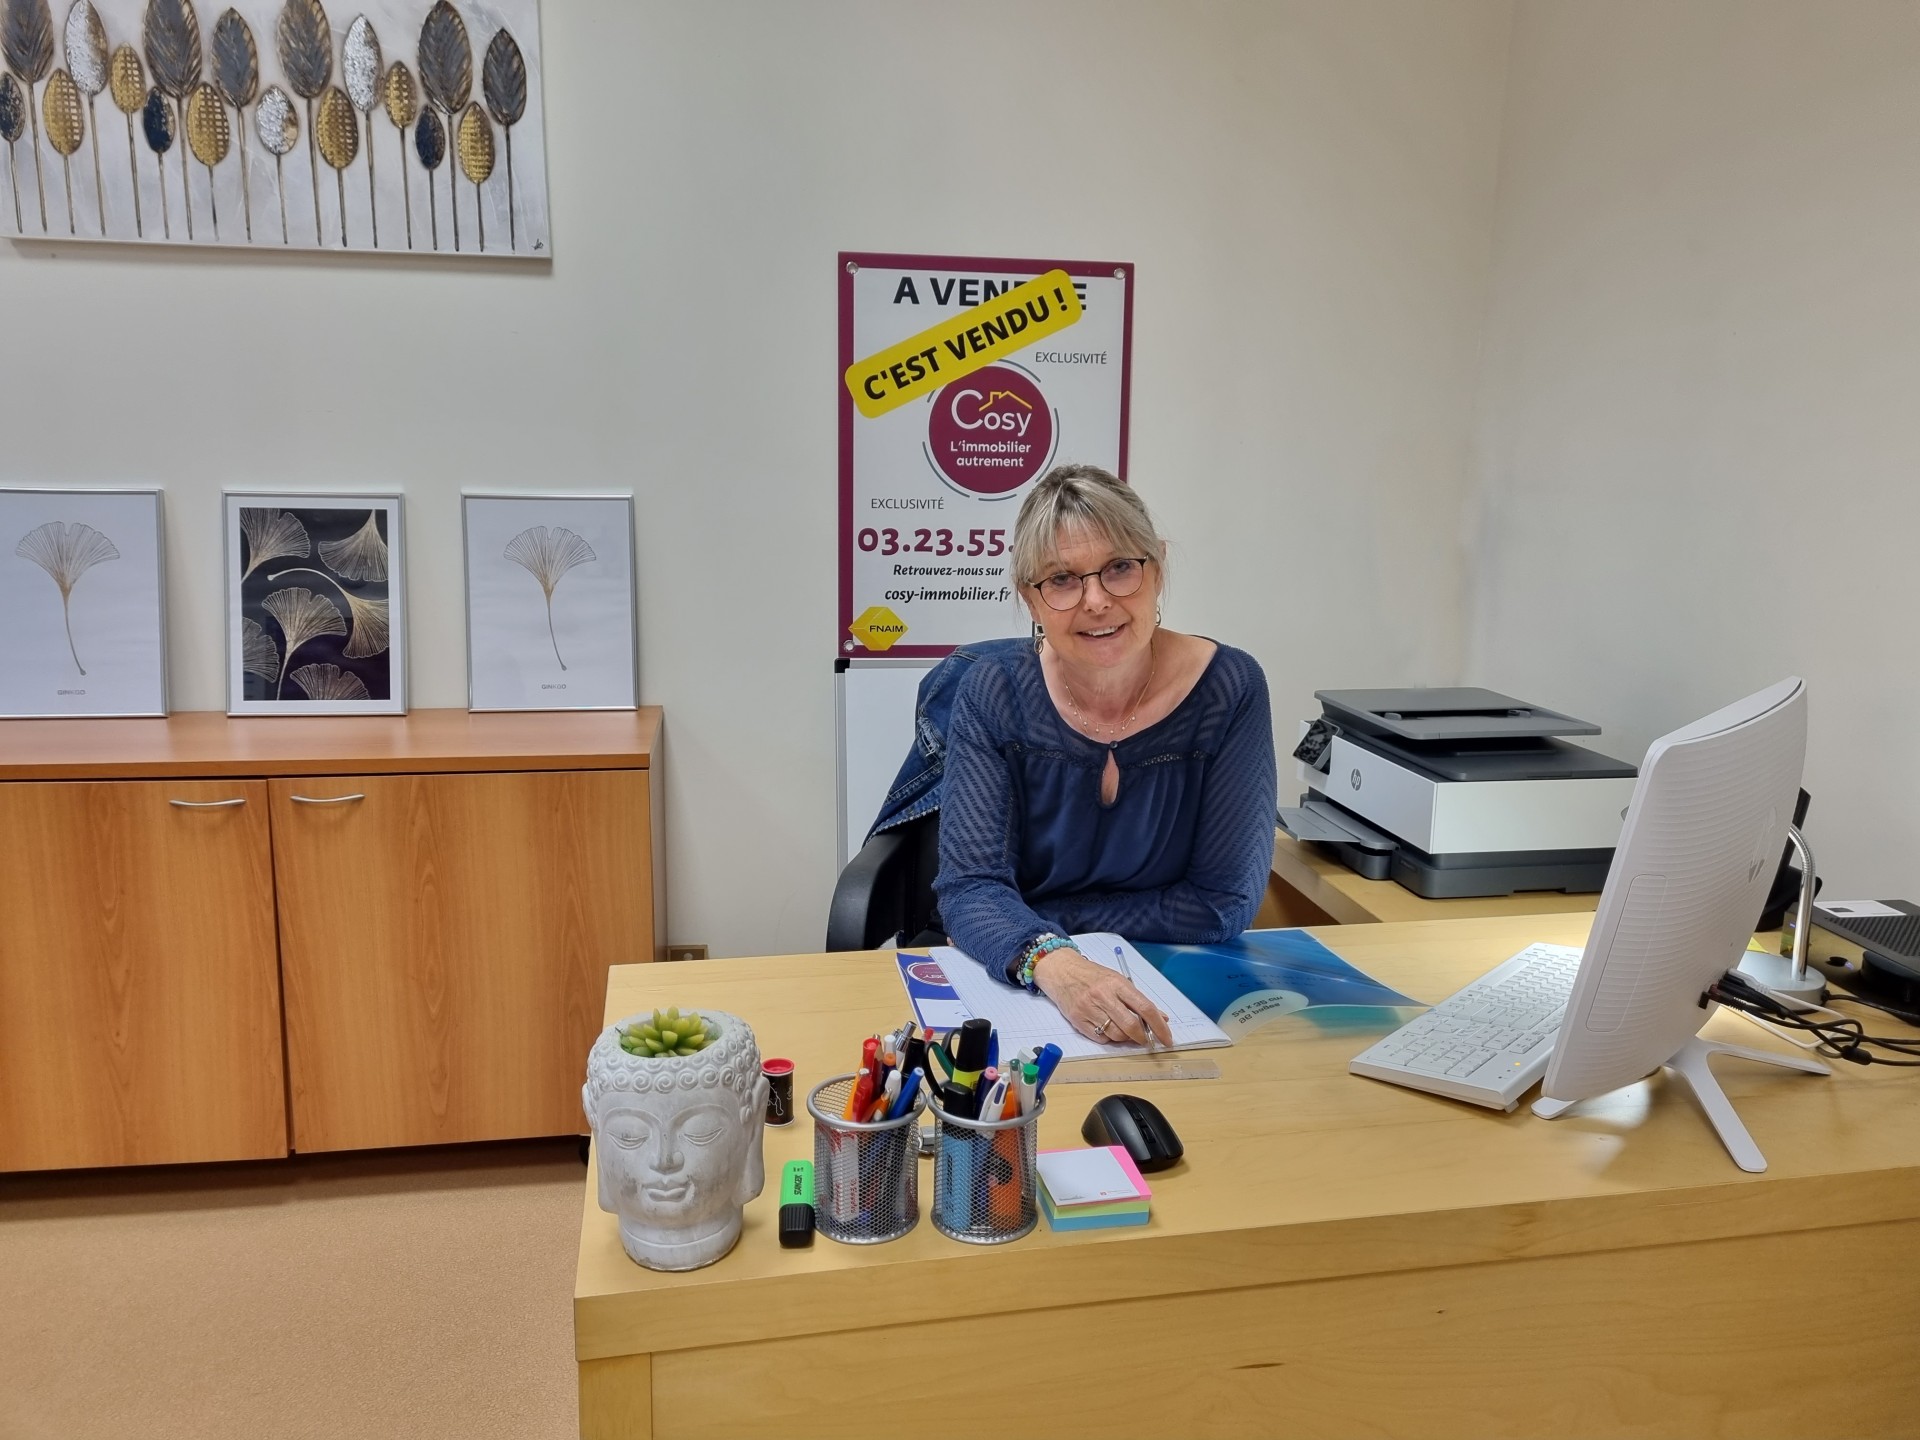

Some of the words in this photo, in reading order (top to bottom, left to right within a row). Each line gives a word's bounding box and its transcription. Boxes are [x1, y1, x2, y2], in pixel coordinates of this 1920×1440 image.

[893, 276, 920, 304] A
[929, 277, 1087, 310] VEN
[863, 346, 940, 400] C'EST
[943, 295, 1050, 361] VENDU
[1053, 287, 1068, 312] !
[1035, 351, 1108, 365] EXCLUSIVITÉ
[951, 389, 1033, 437] Cosy
[950, 440, 1032, 454] L'immobilier
[956, 456, 1024, 468] autrement
[871, 497, 945, 511] EXCLUSIVITÉ
[893, 564, 984, 577] Retrouvez-nous
[985, 566, 1005, 577] sur
[884, 586, 1012, 604] cosy-immobilier.fr
[869, 625, 904, 633] FNAIM
